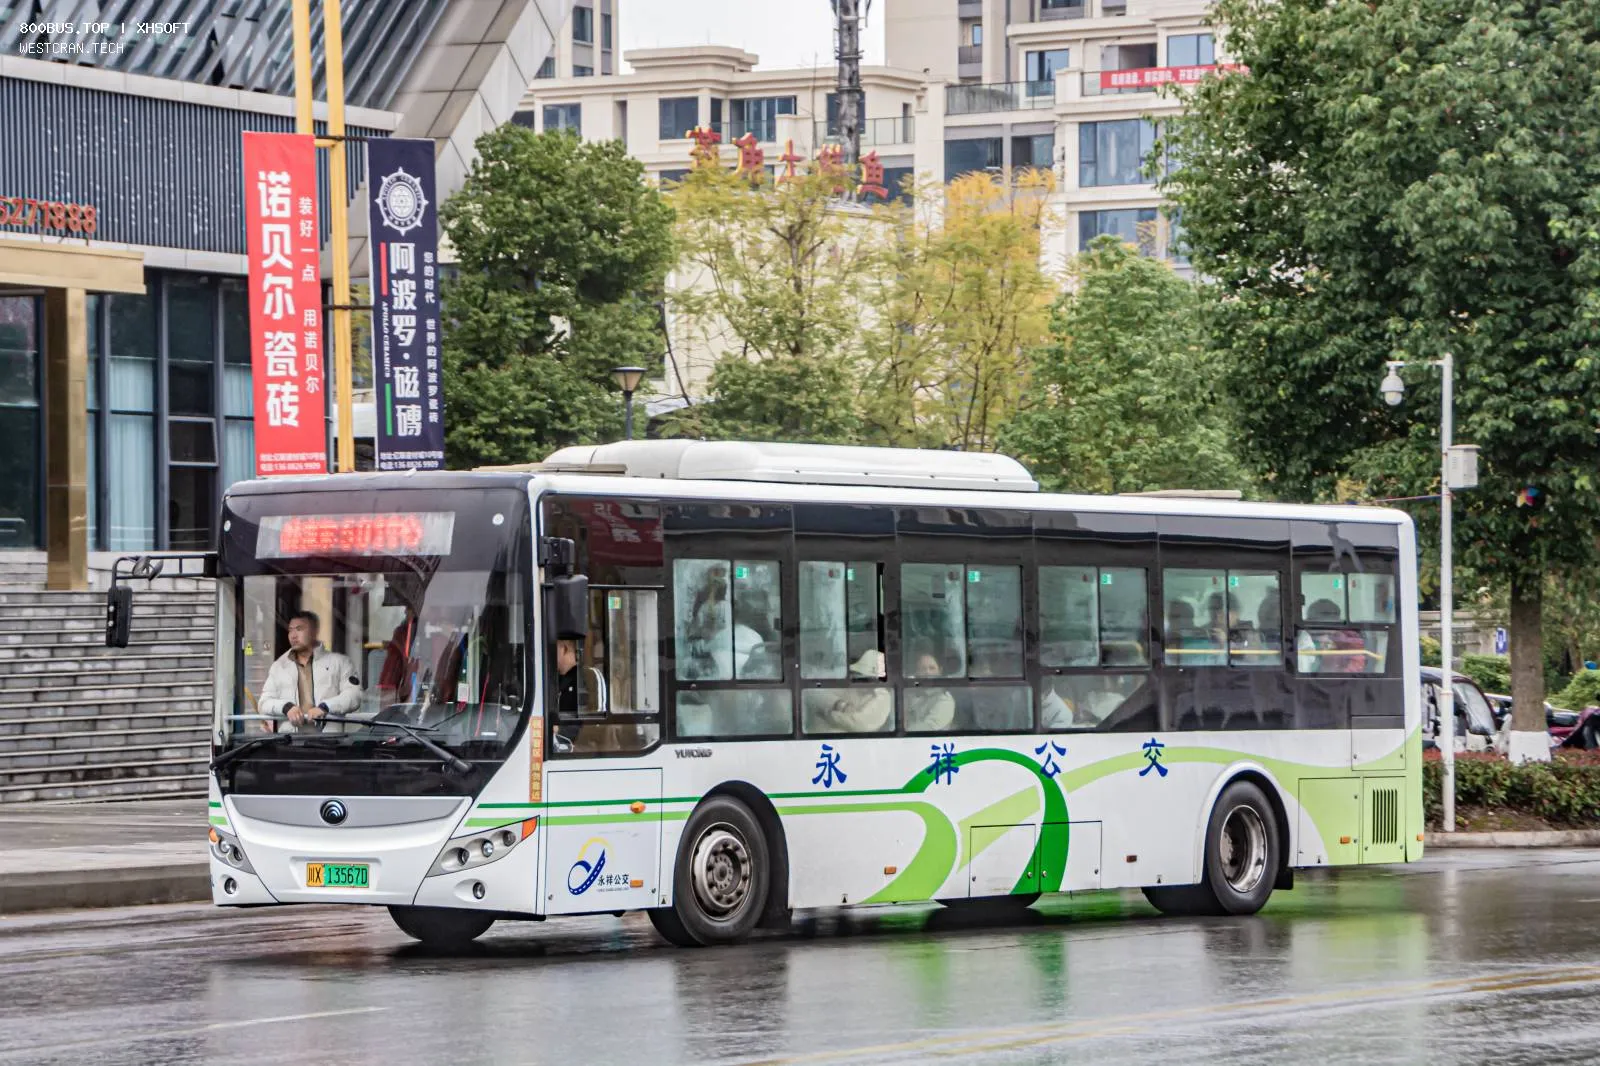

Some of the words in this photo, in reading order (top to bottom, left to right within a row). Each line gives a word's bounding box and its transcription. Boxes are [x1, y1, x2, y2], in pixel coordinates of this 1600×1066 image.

[0, 196, 97, 233] 5271888
[299, 196, 316, 282] 装好一点
[257, 171, 299, 427] 诺贝尔瓷砖
[304, 309, 320, 394] 用诺贝尔
[812, 738, 1168, 788] 永祥公交
[597, 873, 629, 887] 永祥公交
